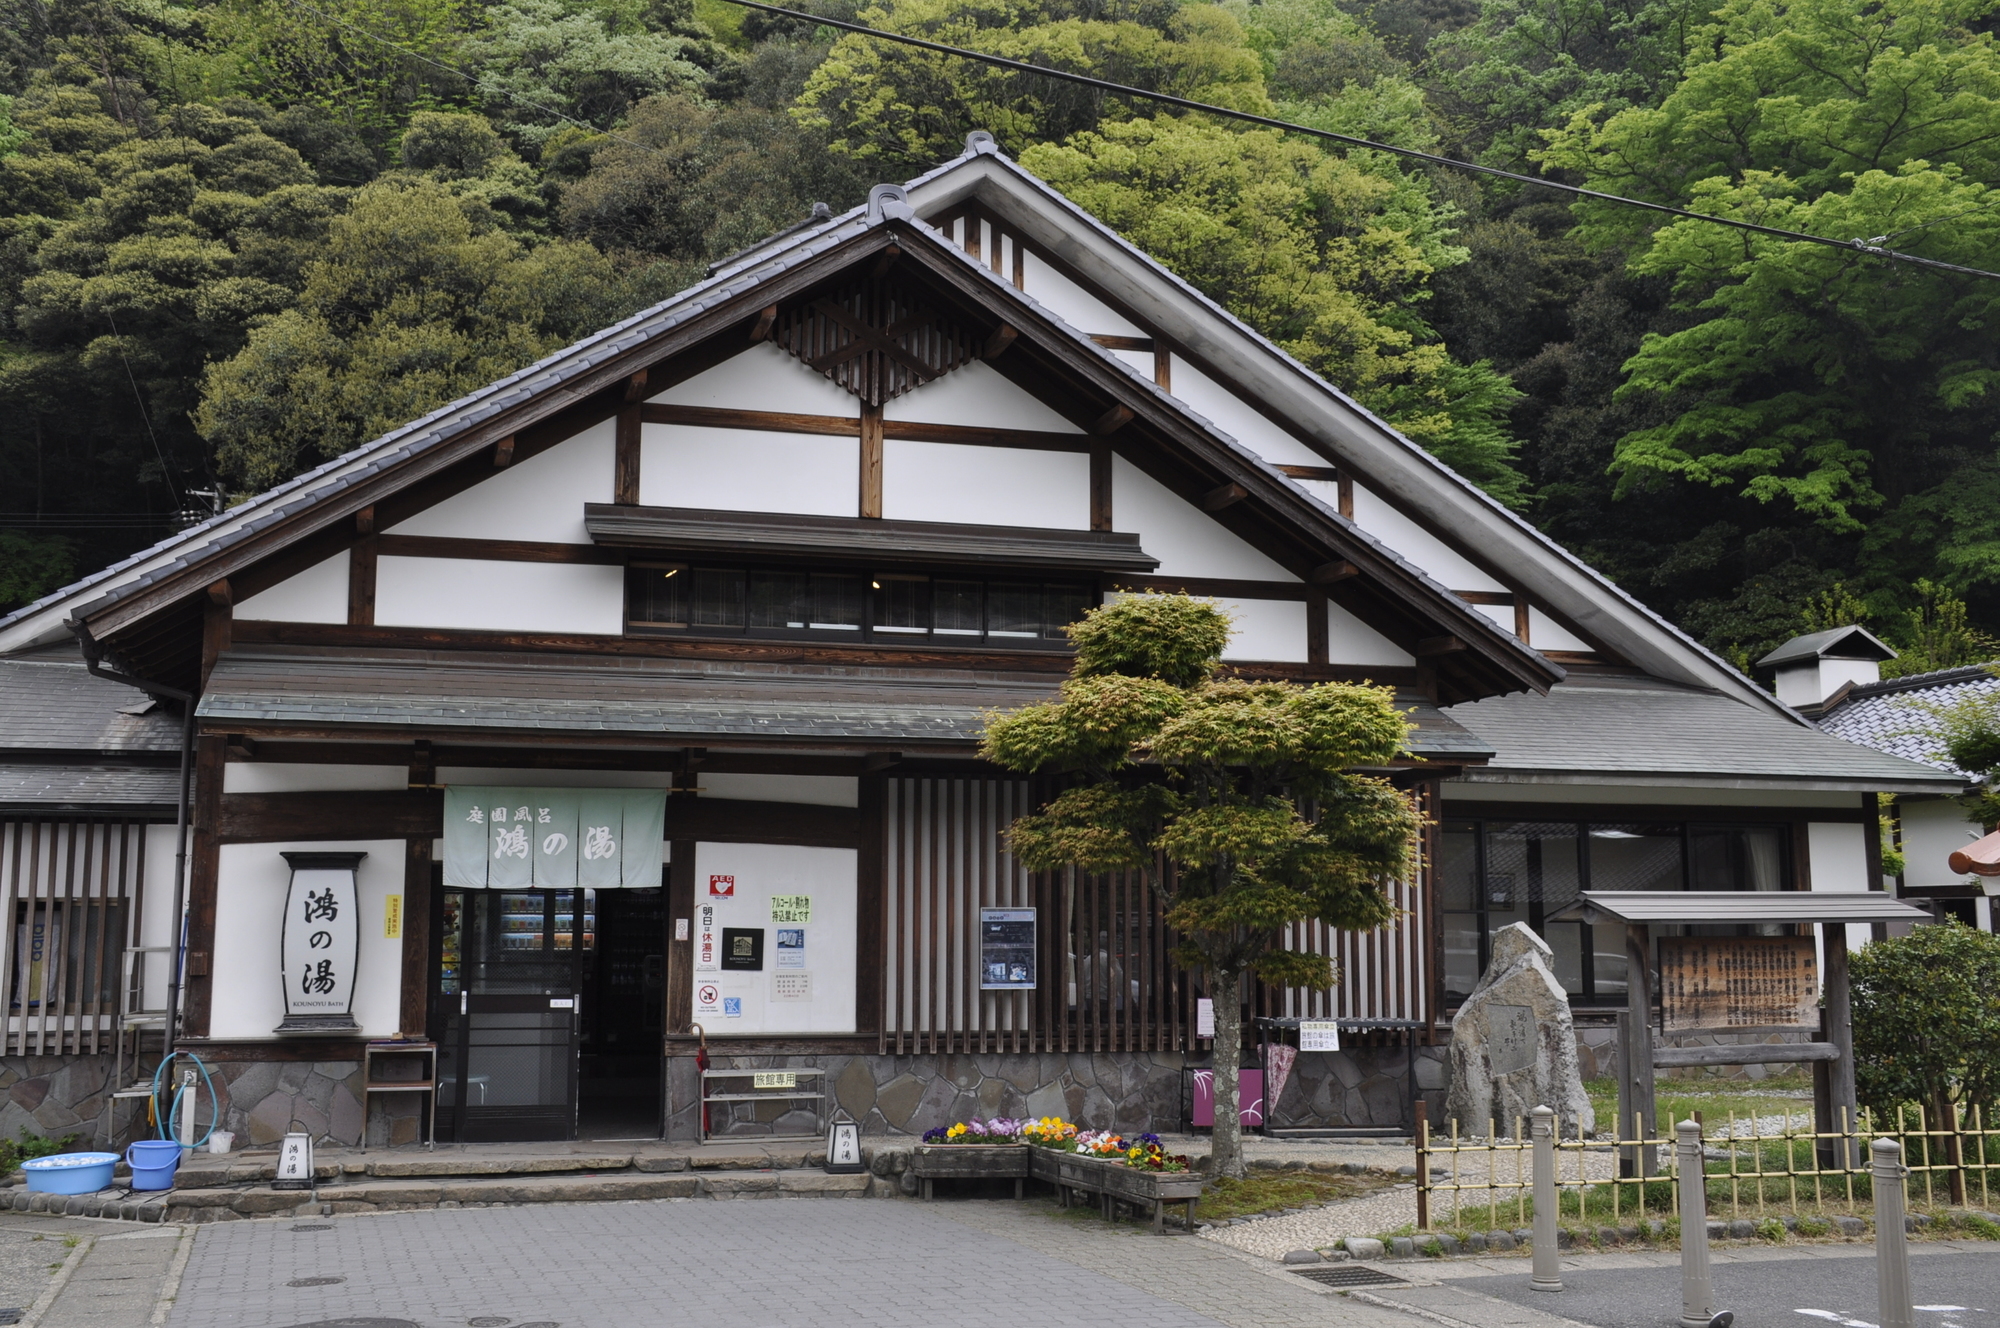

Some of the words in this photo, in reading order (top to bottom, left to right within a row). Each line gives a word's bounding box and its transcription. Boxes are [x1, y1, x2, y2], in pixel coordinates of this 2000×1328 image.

[466, 806, 552, 824] 庭園風呂
[494, 825, 616, 860] 鴻の湯
[771, 910, 809, 922] 持込禁止です
[302, 887, 339, 995] 鴻の湯
[702, 906, 712, 962] 明日は休湯日
[1302, 1031, 1335, 1039] 旅館の傘は旅
[1302, 1040, 1336, 1049] 館専用傘立へ
[755, 1073, 795, 1085] 旅館専用
[841, 1128, 852, 1160] 鴻の湯
[287, 1144, 298, 1174] 鴻の湯
